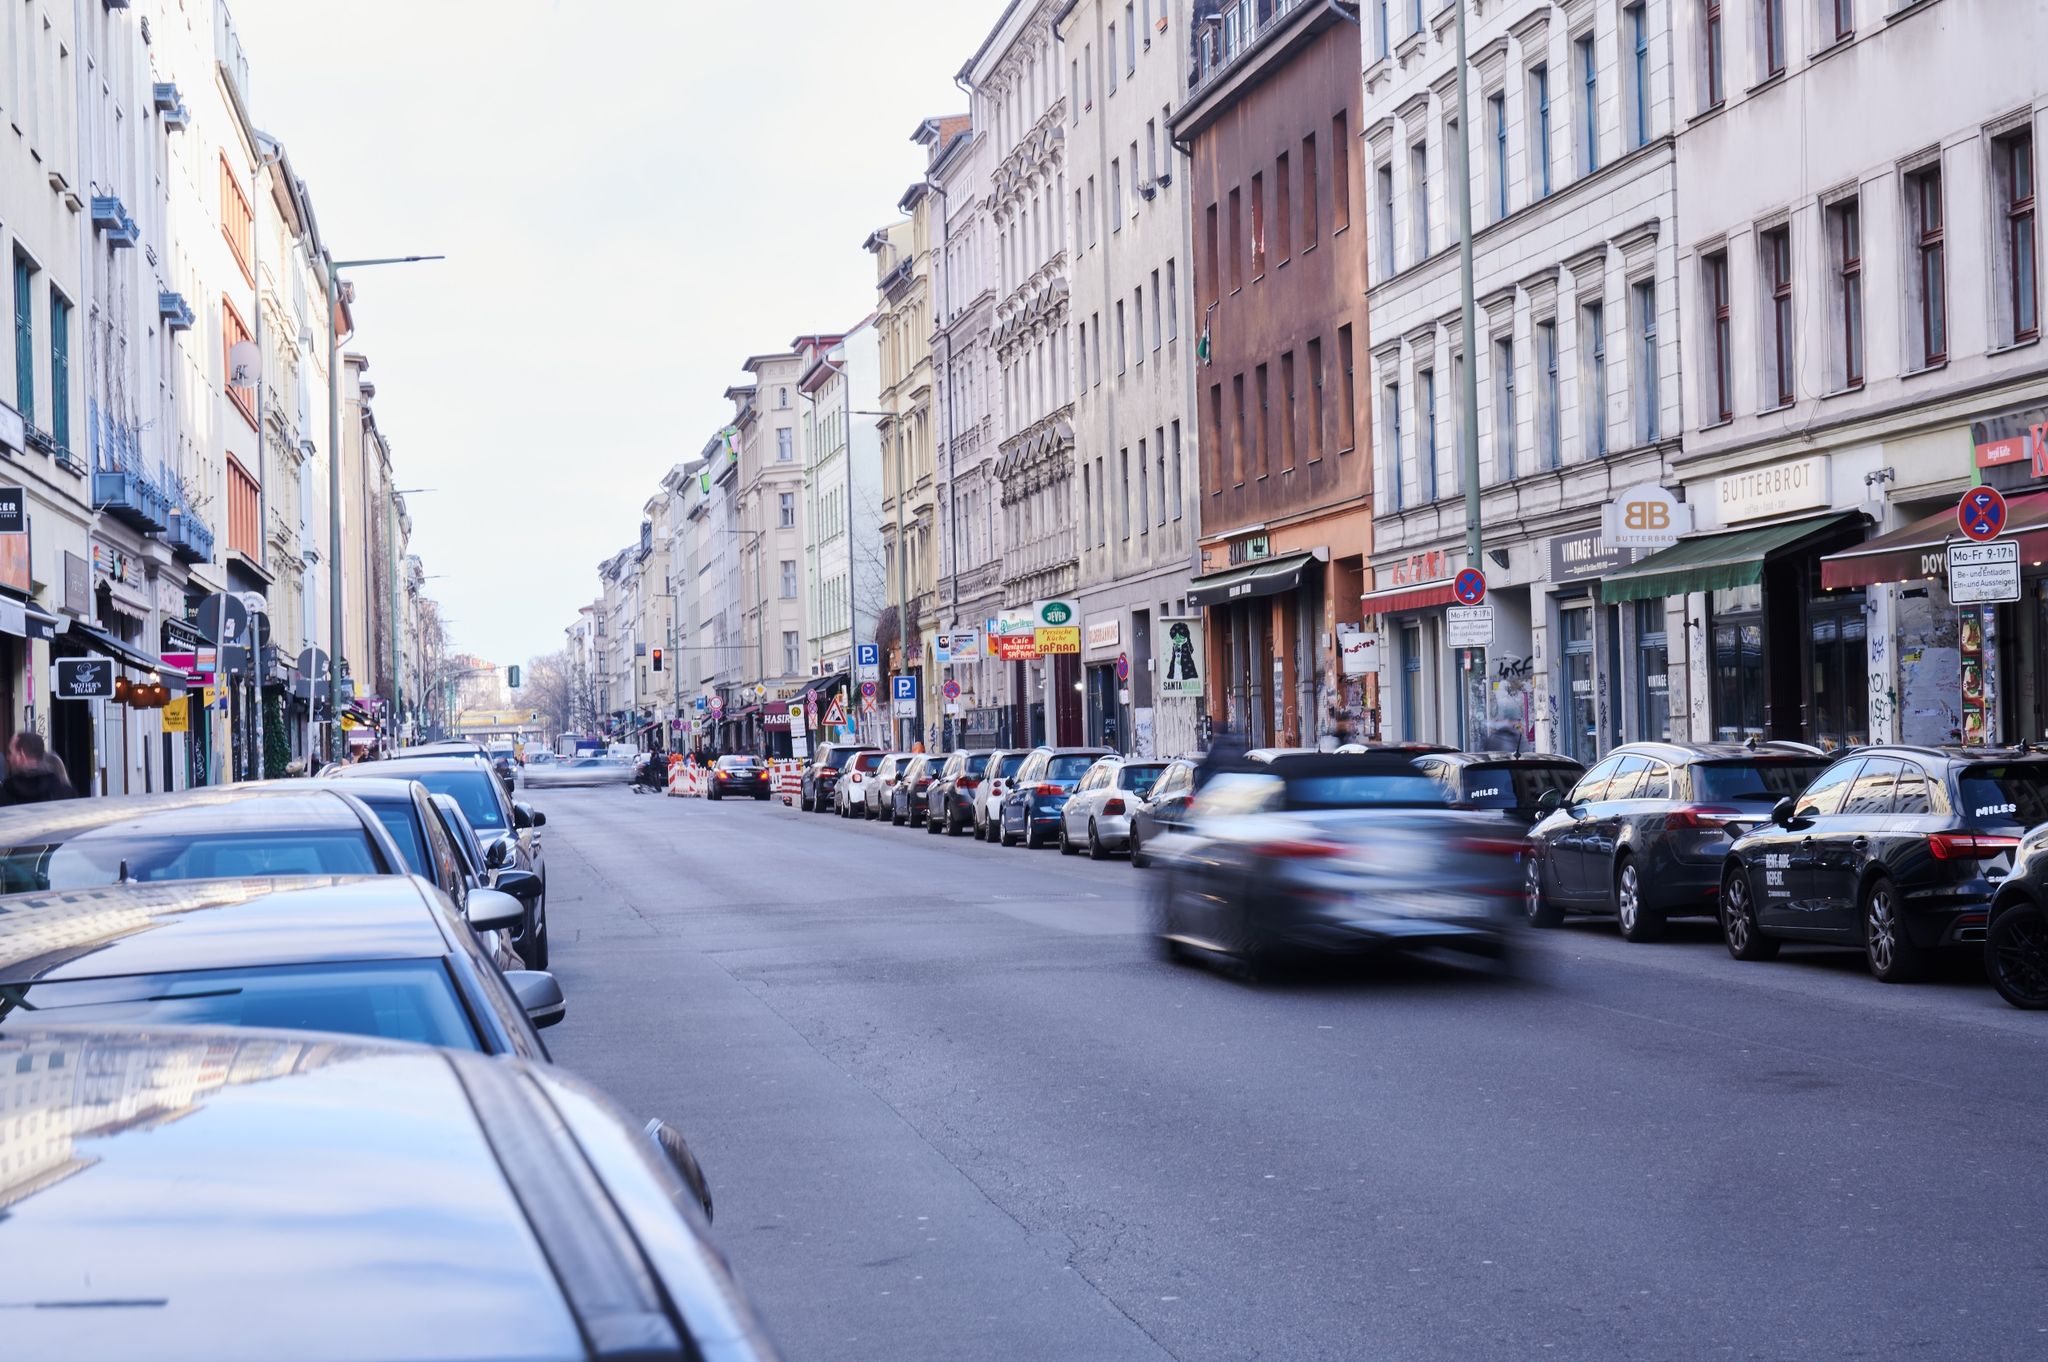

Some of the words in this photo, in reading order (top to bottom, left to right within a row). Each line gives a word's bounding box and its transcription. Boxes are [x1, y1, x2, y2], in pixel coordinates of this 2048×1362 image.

[1722, 463, 1811, 503] BUTTERBROT
[1561, 538, 1591, 563] VINTAGE
[1953, 549, 1983, 561] Mo-Fr
[1047, 611, 1067, 622] JEVER
[1039, 642, 1076, 653] SAFRAN
[862, 647, 873, 663] P
[1163, 681, 1183, 691] SANTA
[1647, 673, 1667, 688] VINTAGE
[898, 679, 911, 697] P
[764, 714, 791, 724] HASIR
[1470, 788, 1499, 799] MILES
[1975, 803, 2017, 818] MILES
